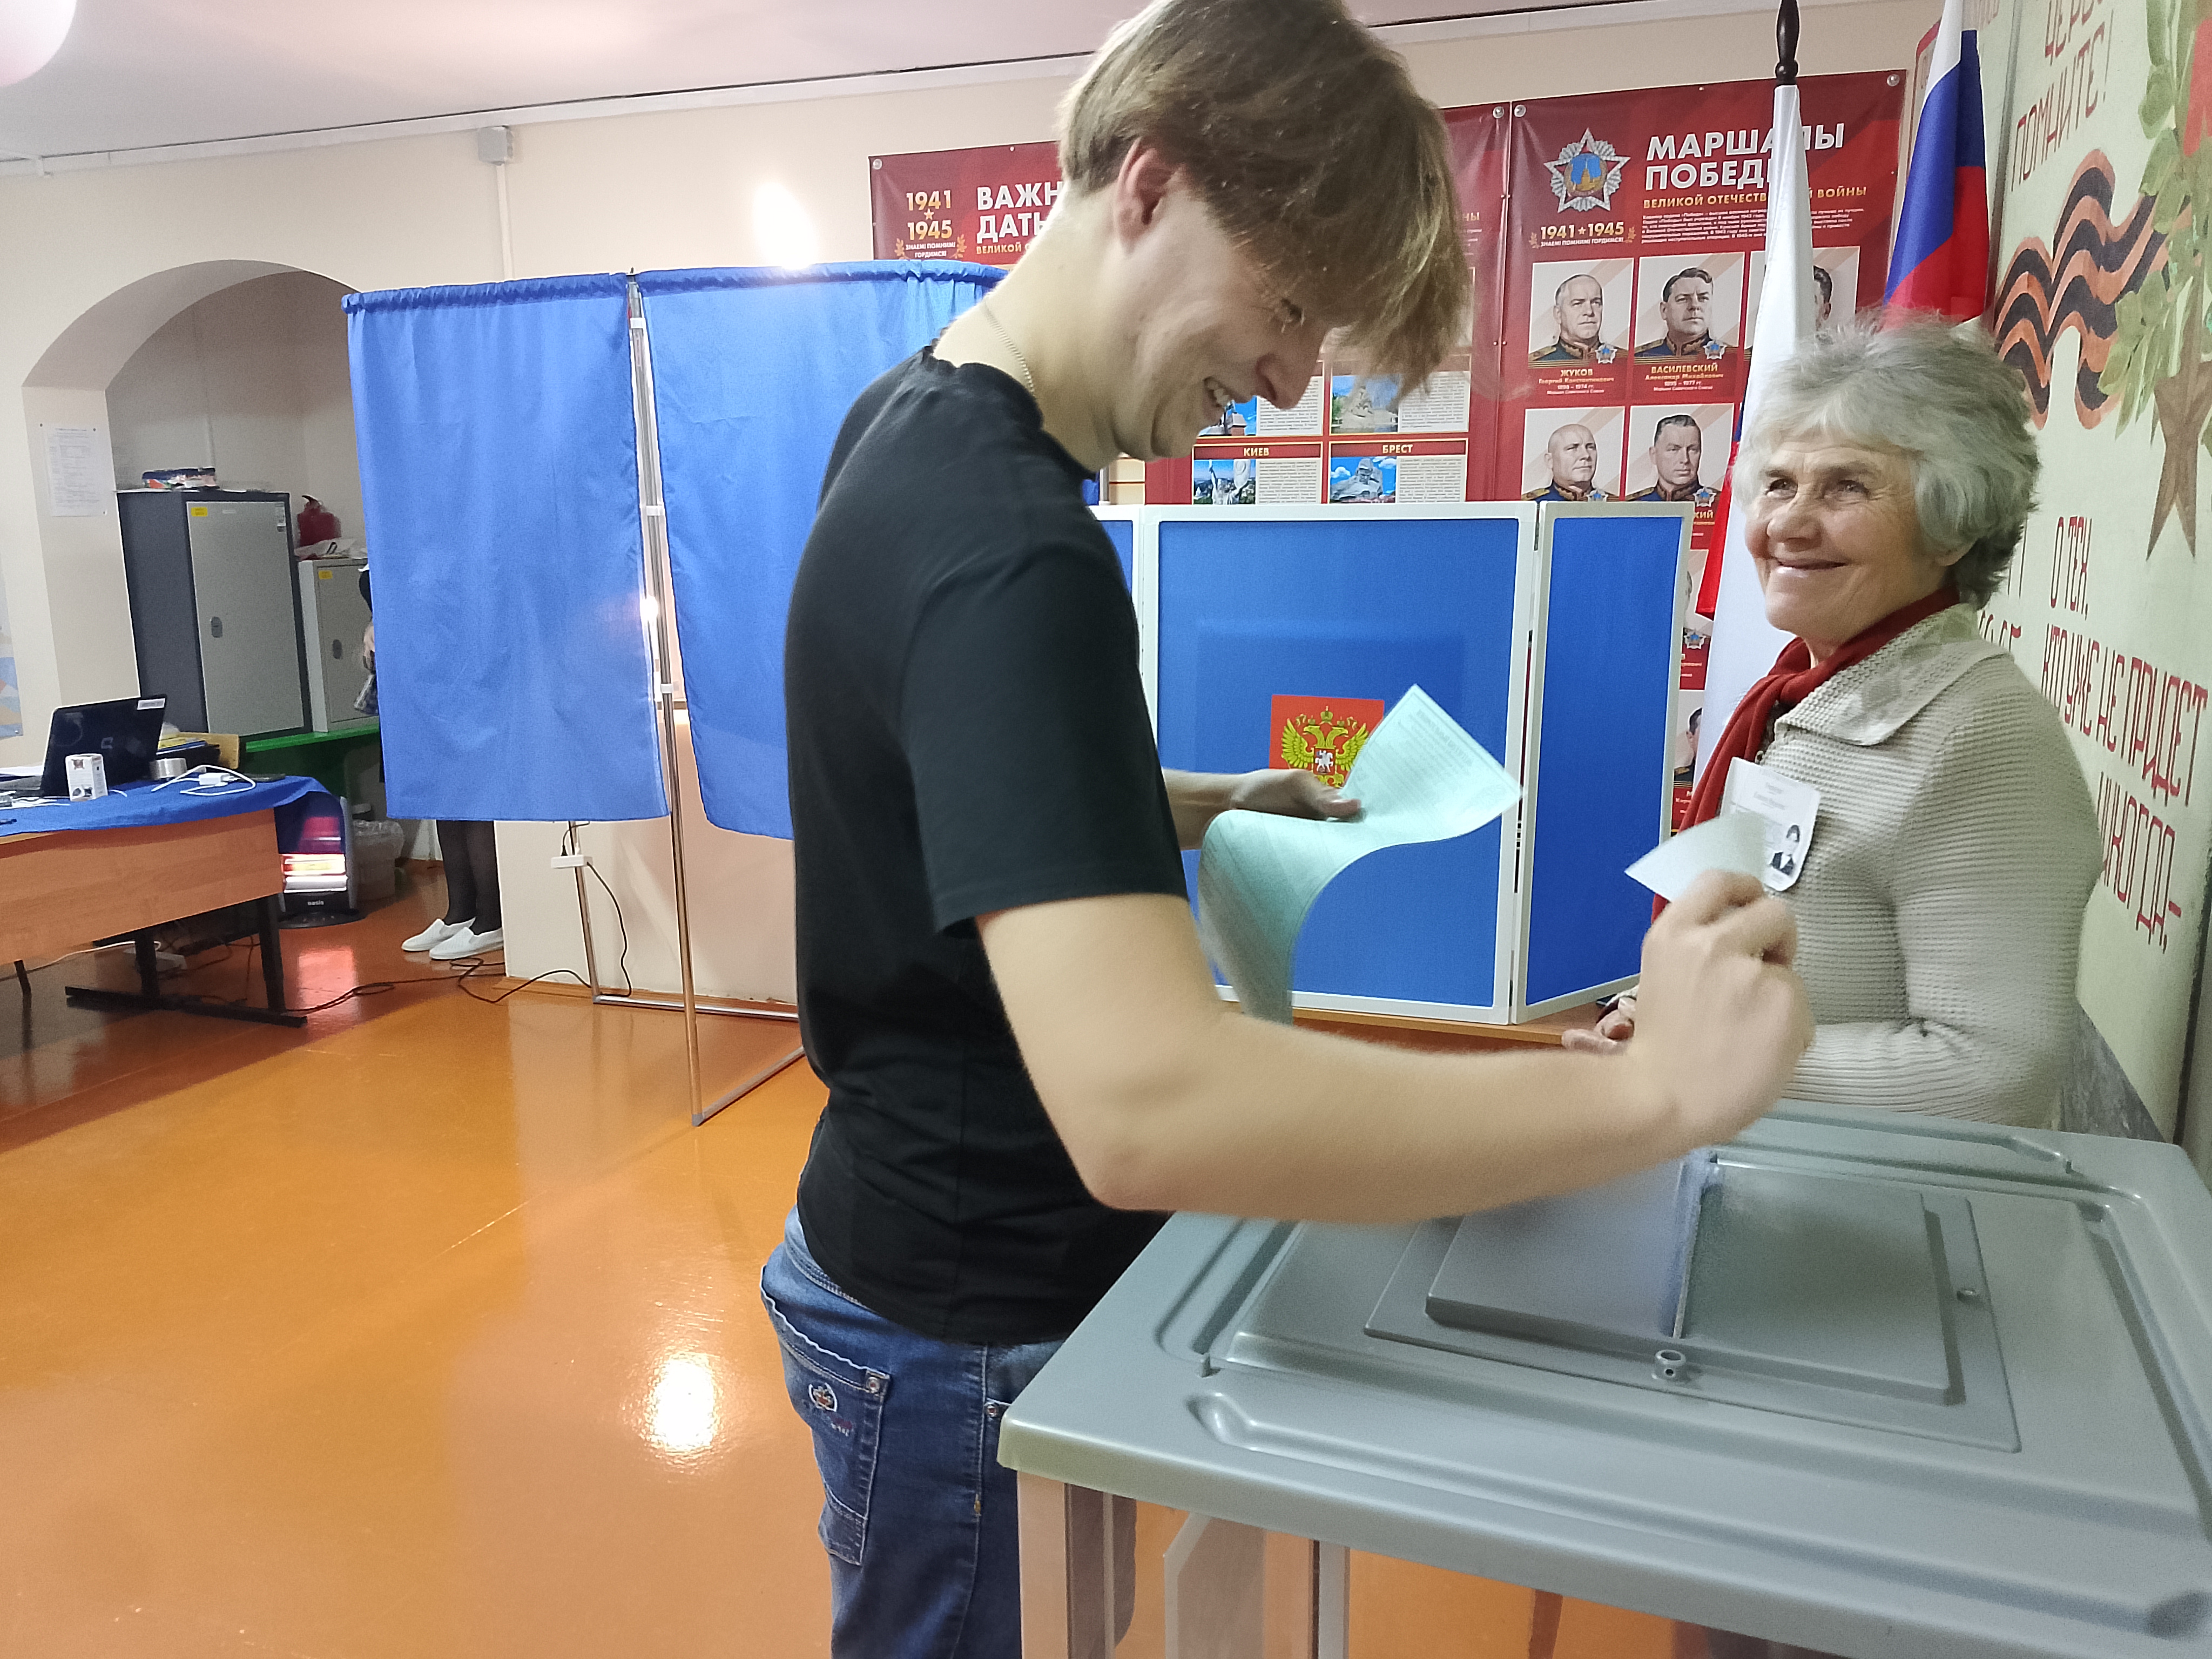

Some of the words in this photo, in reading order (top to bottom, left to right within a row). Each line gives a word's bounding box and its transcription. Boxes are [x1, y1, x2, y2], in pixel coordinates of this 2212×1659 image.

[2011, 9, 2114, 192] ПОМНИТЕ!
[1645, 158, 1771, 191] ПОБЕД
[906, 190, 951, 211] 1941
[977, 181, 1064, 211] ВАЖН
[1643, 193, 1703, 208] ВЕЛИКОЙ
[1817, 185, 1866, 199] ВОЙНЫ
[907, 220, 952, 240] 1945
[1540, 225, 1575, 240] 1941
[1588, 221, 1624, 237] 1945
[976, 241, 1022, 254] ВЕЛИКОЙ
[1560, 368, 1593, 377] ЖУКОВ
[1651, 362, 1718, 374] ВАСИЛЕВСКИЙ
[1243, 447, 1269, 457] КИЕВ
[1382, 444, 1413, 454] БРЕСТ
[2096, 646, 2125, 752] НЕ
[2120, 656, 2208, 807] ПРИДЕТ
